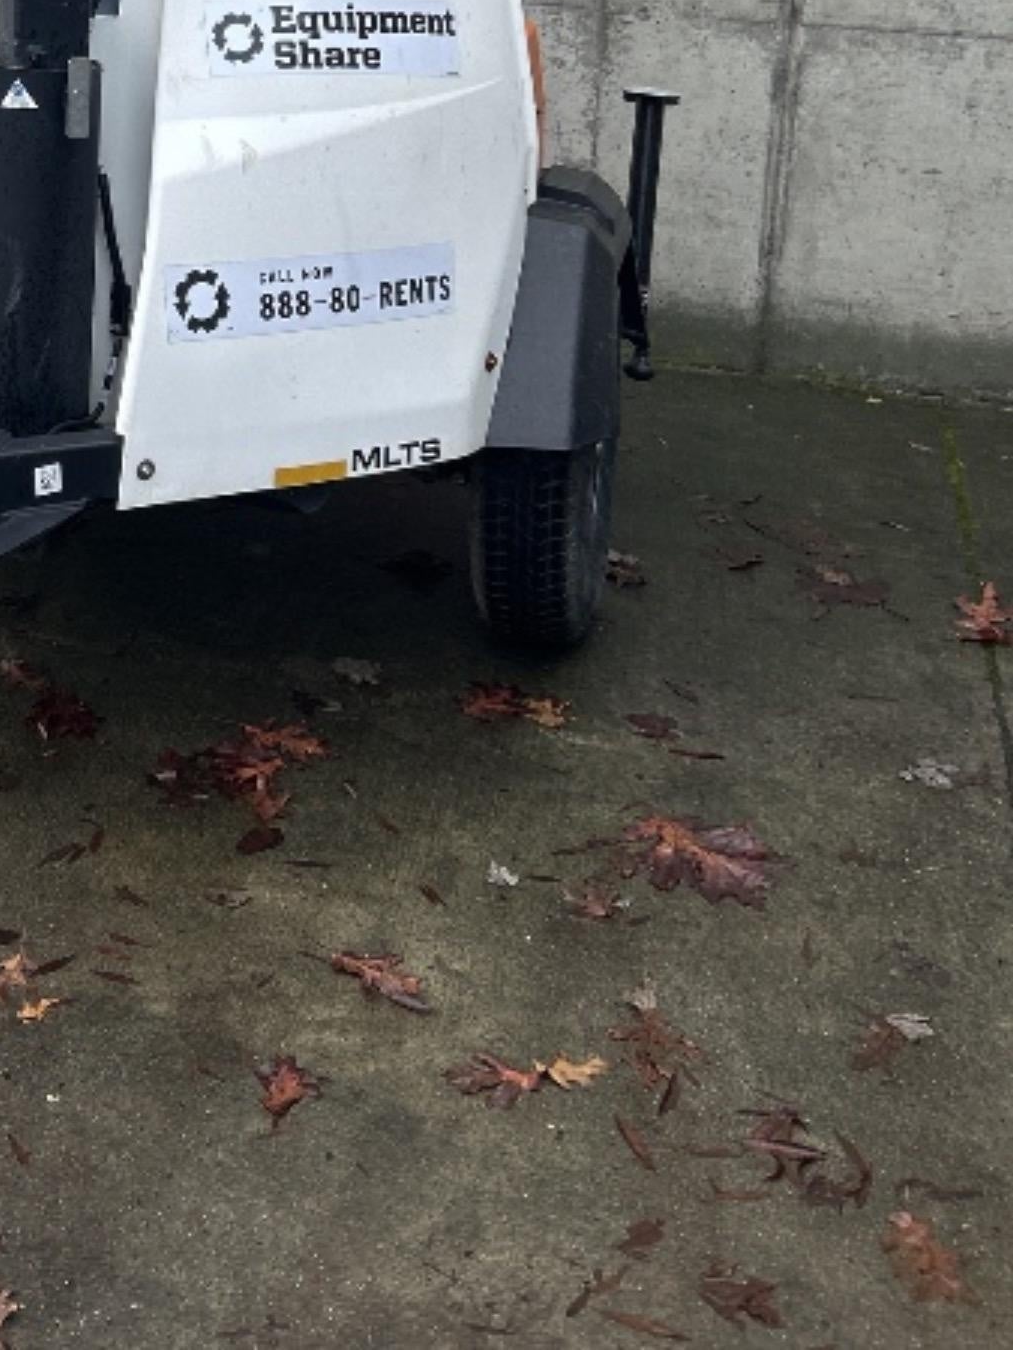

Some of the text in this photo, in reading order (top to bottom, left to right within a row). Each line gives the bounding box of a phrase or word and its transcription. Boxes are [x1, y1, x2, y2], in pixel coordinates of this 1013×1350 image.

[269, 3, 456, 40] Equipment
[274, 39, 382, 70] Share
[352, 437, 441, 472] MLTS
